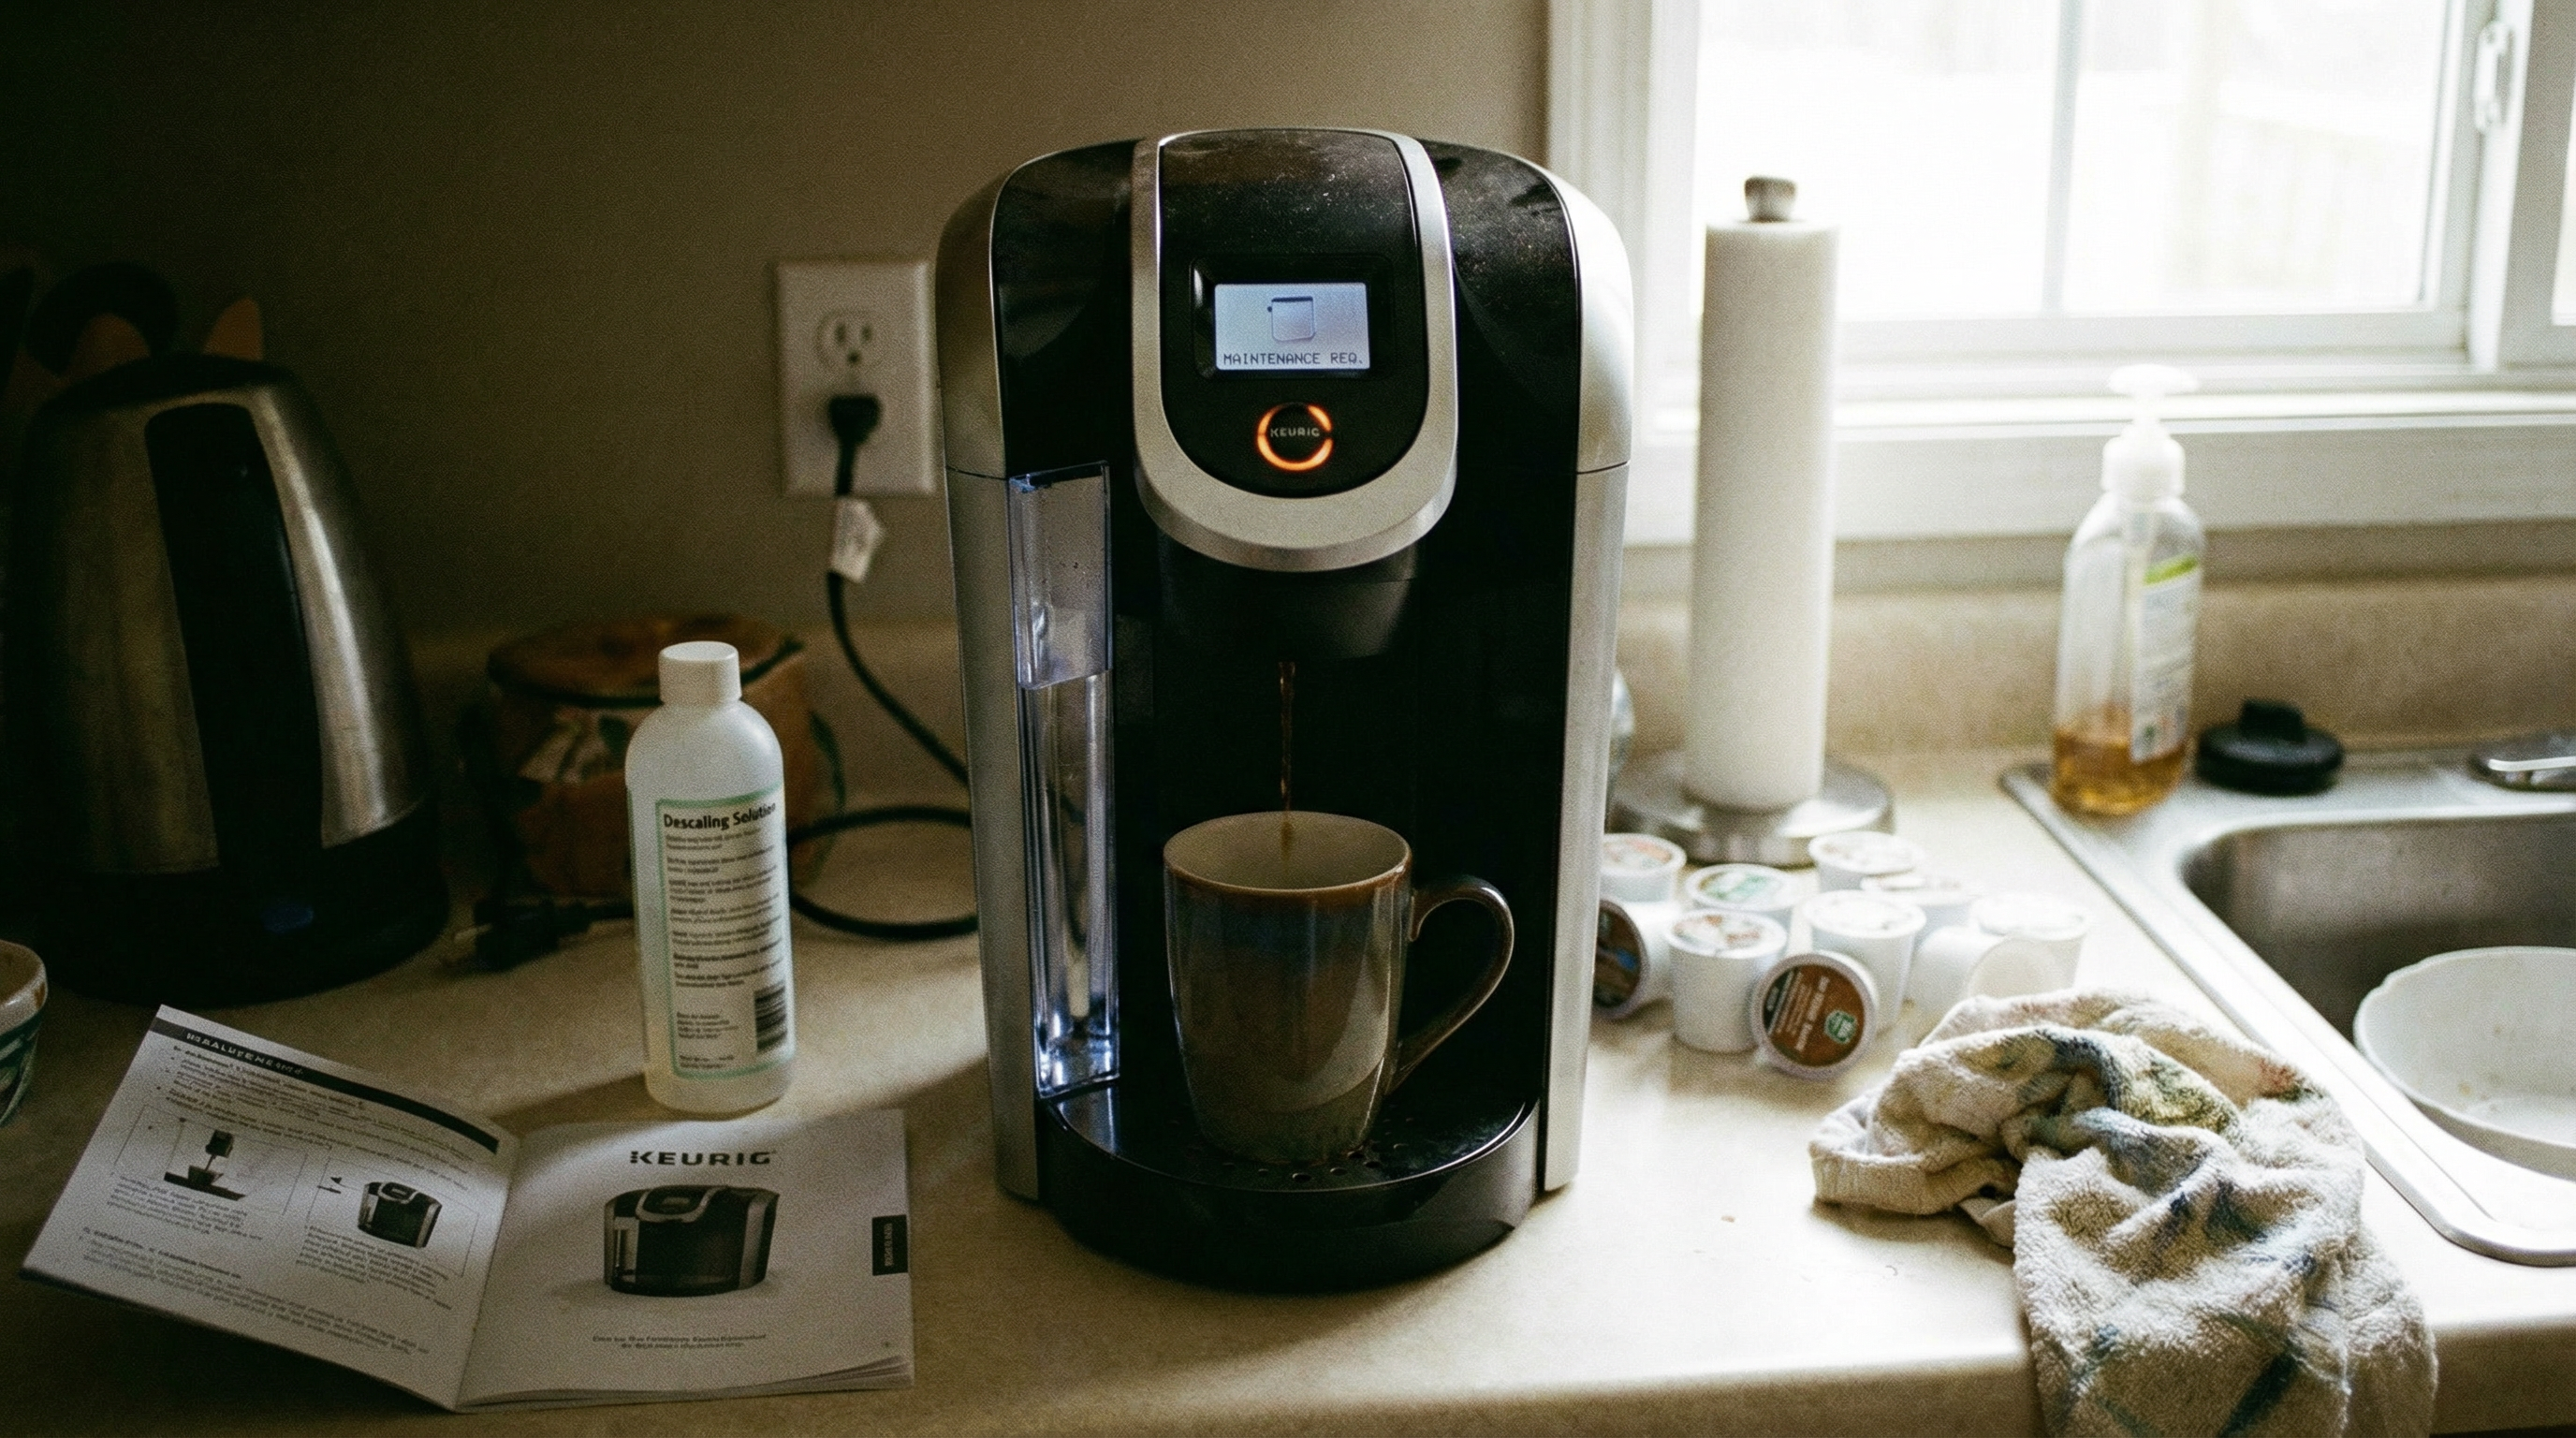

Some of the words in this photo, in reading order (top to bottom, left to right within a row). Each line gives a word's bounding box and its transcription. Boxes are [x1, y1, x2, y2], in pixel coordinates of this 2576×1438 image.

[1222, 352, 1321, 364] MAINTENANCE
[1330, 351, 1364, 365] REQ.
[1270, 427, 1320, 437] KEURIG
[664, 814, 730, 830] Descaling
[630, 1151, 771, 1166] KEURIG
